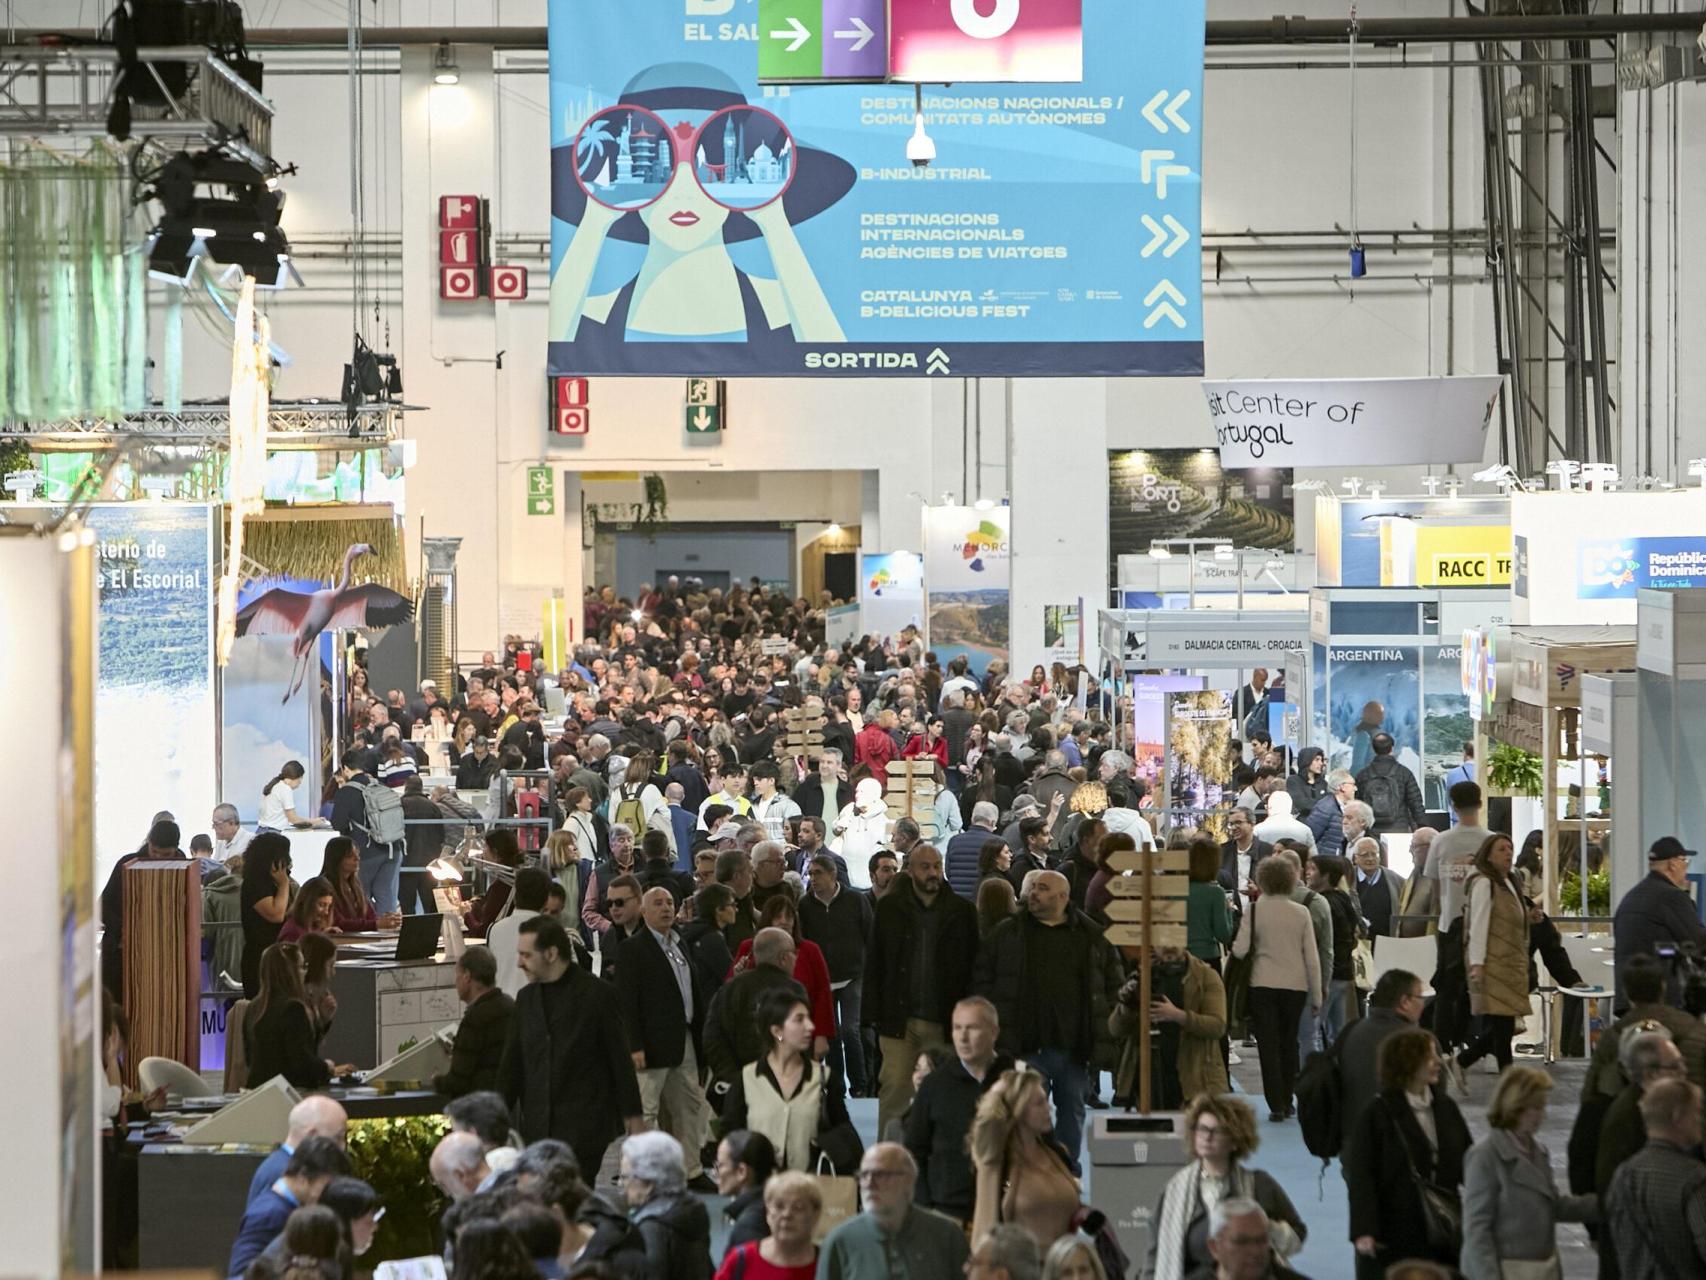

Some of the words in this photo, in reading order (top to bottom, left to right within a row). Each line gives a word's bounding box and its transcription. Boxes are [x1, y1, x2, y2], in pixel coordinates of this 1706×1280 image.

[685, 24, 712, 41] EL
[861, 97, 999, 110] DESTINACIONS
[1004, 97, 1112, 110] NACIONALS
[987, 111, 1105, 125] AUTÒNOMES
[861, 168, 991, 180] B-INDUSTRIAL
[861, 213, 999, 225] DESTINACIONS
[861, 229, 1024, 241] INTERNACIONALS
[861, 245, 954, 259] AGÈNCIES
[959, 247, 982, 259] DE
[988, 247, 1067, 259] VIATGES
[861, 290, 972, 302] CATALUNYA
[861, 305, 978, 318] B-DELICIOUS
[982, 305, 1030, 318] FEST
[805, 352, 918, 368] SORTIDA
[1226, 390, 1317, 417] Center
[1327, 402, 1365, 424] of
[146, 540, 166, 559] de
[1439, 560, 1485, 577] RACC
[111, 568, 127, 589] El
[133, 568, 201, 589] Escorial
[1185, 640, 1224, 650] DALMACIA
[1226, 640, 1261, 650] CENTRAL
[1267, 640, 1303, 650] CROACIA
[1329, 650, 1404, 661] ARGENTINA
[202, 1010, 227, 1034] MU
